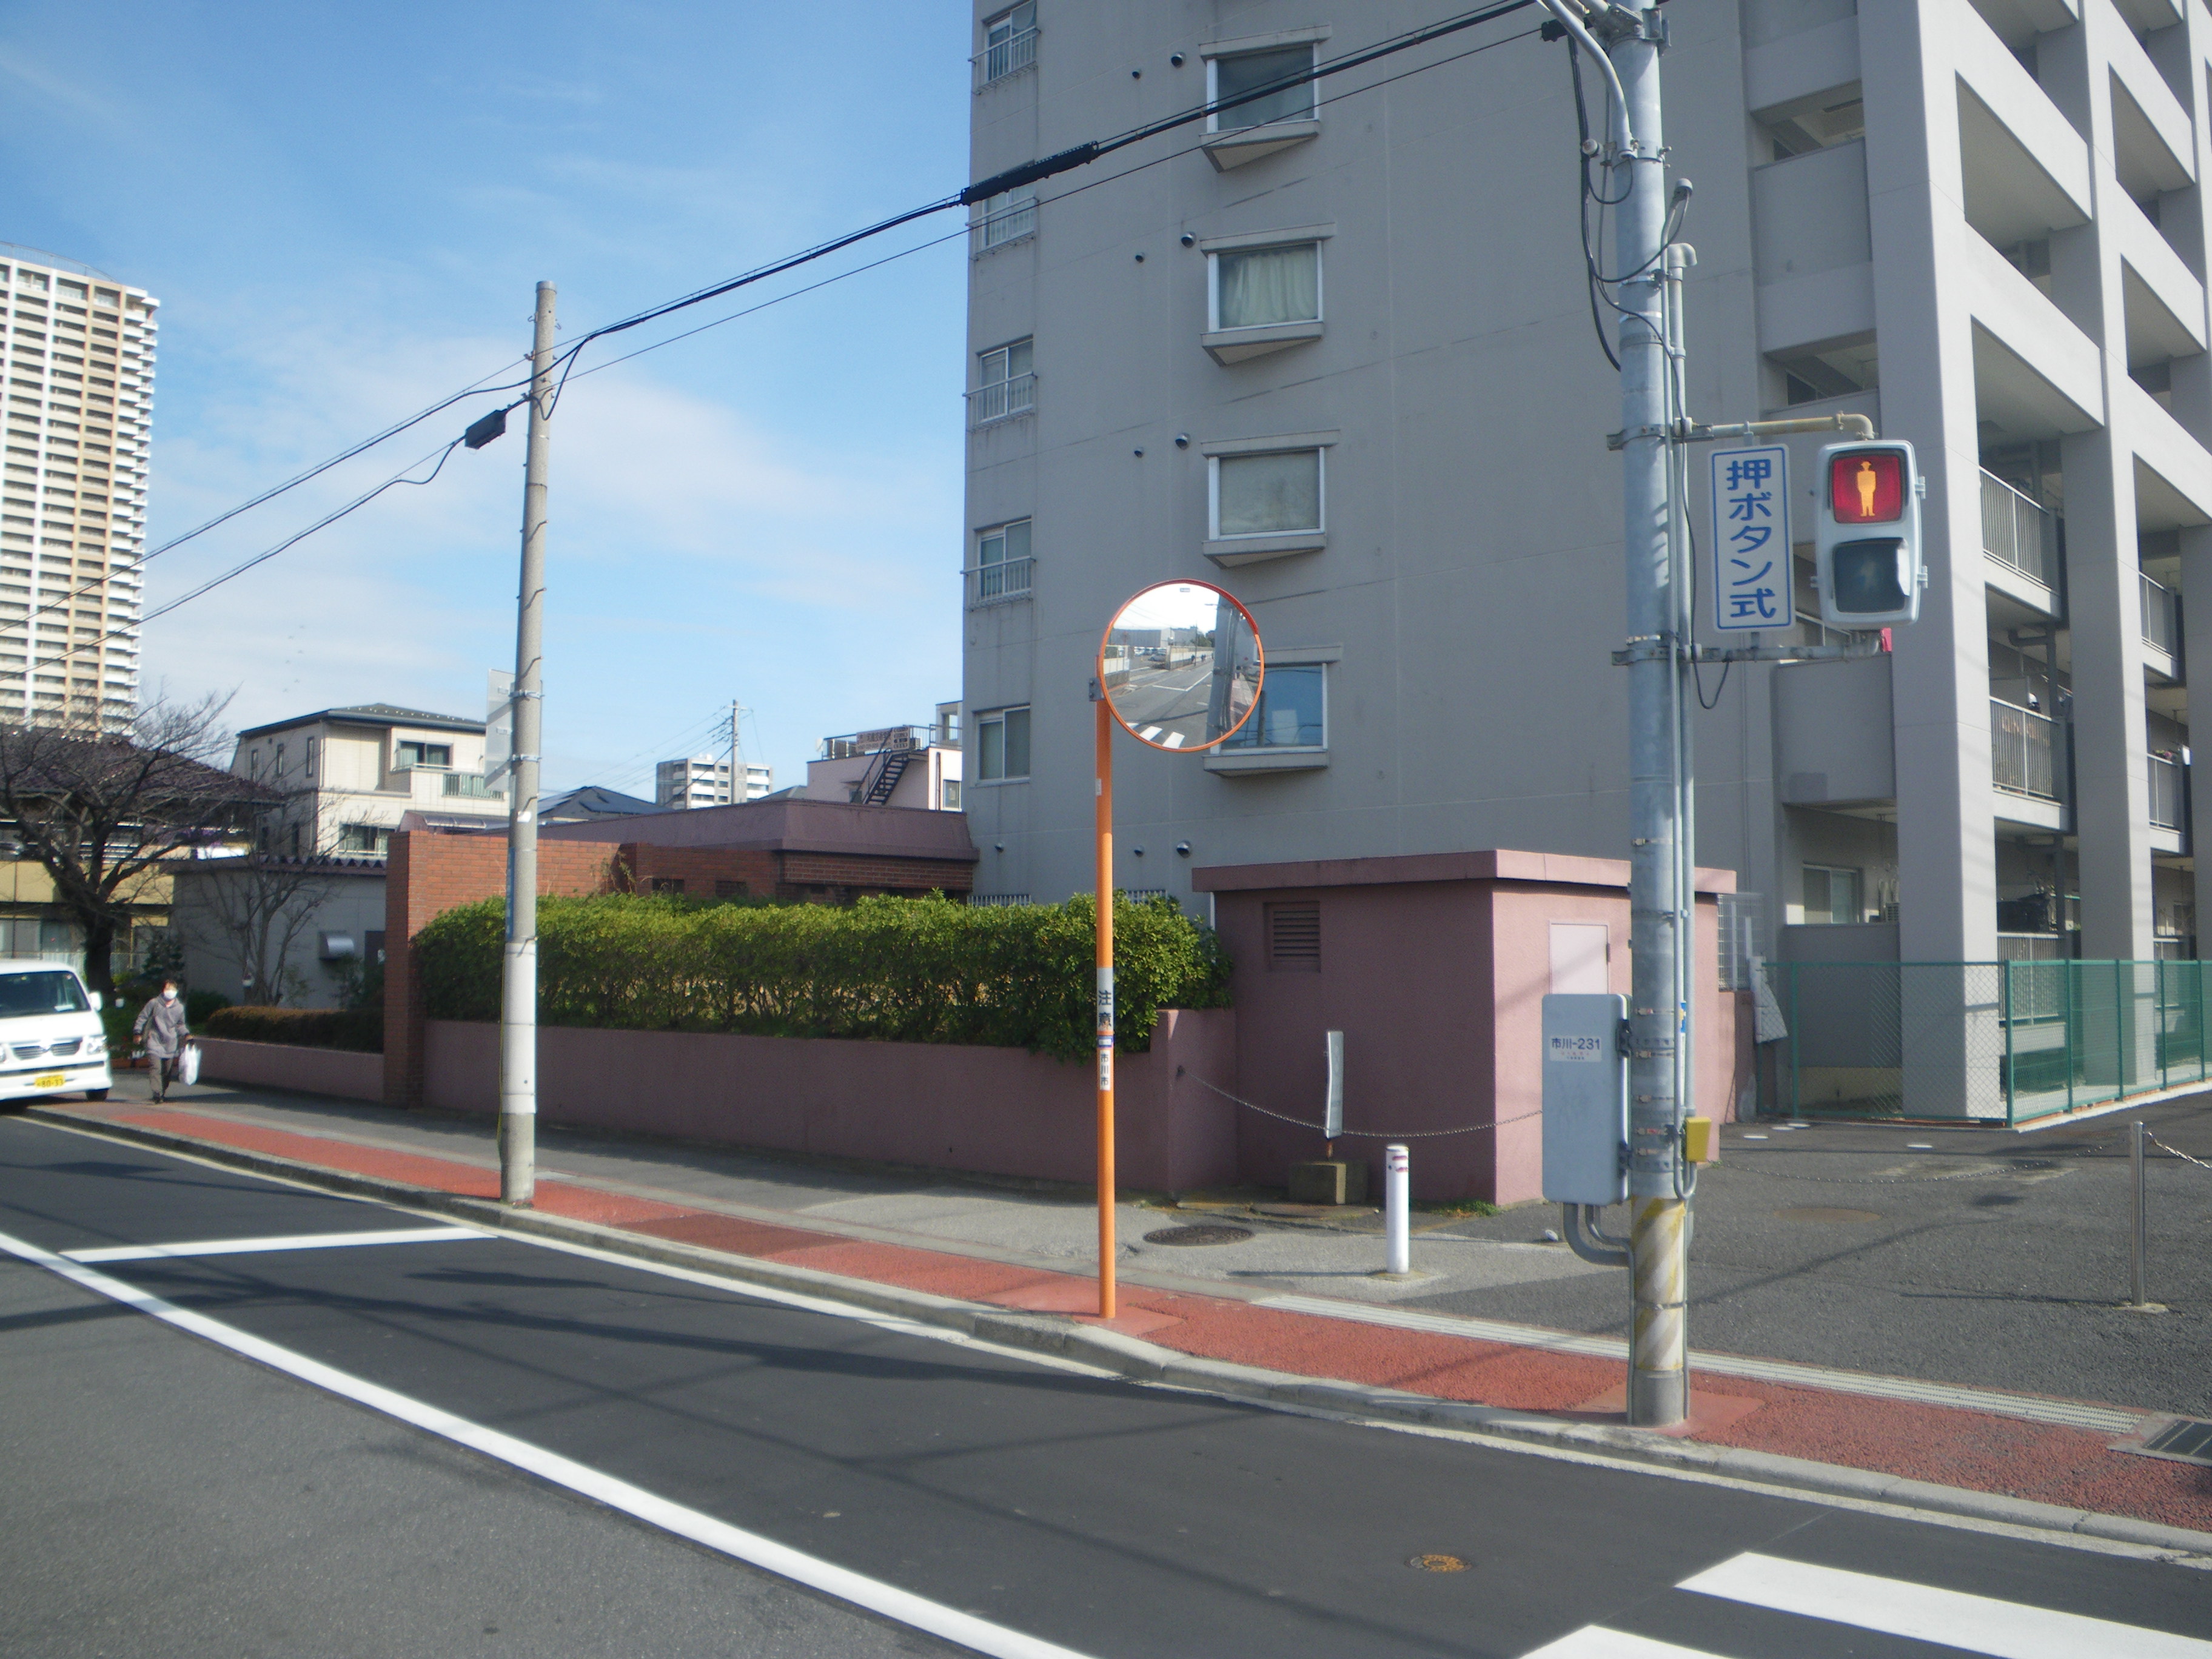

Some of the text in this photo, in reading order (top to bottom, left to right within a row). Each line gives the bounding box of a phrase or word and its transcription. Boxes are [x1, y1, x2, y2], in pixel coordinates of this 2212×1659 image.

[1726, 458, 1777, 618] 押ボタン式
[1551, 1037, 1600, 1050] 市川-231
[1101, 1053, 1109, 1086] 市川市
